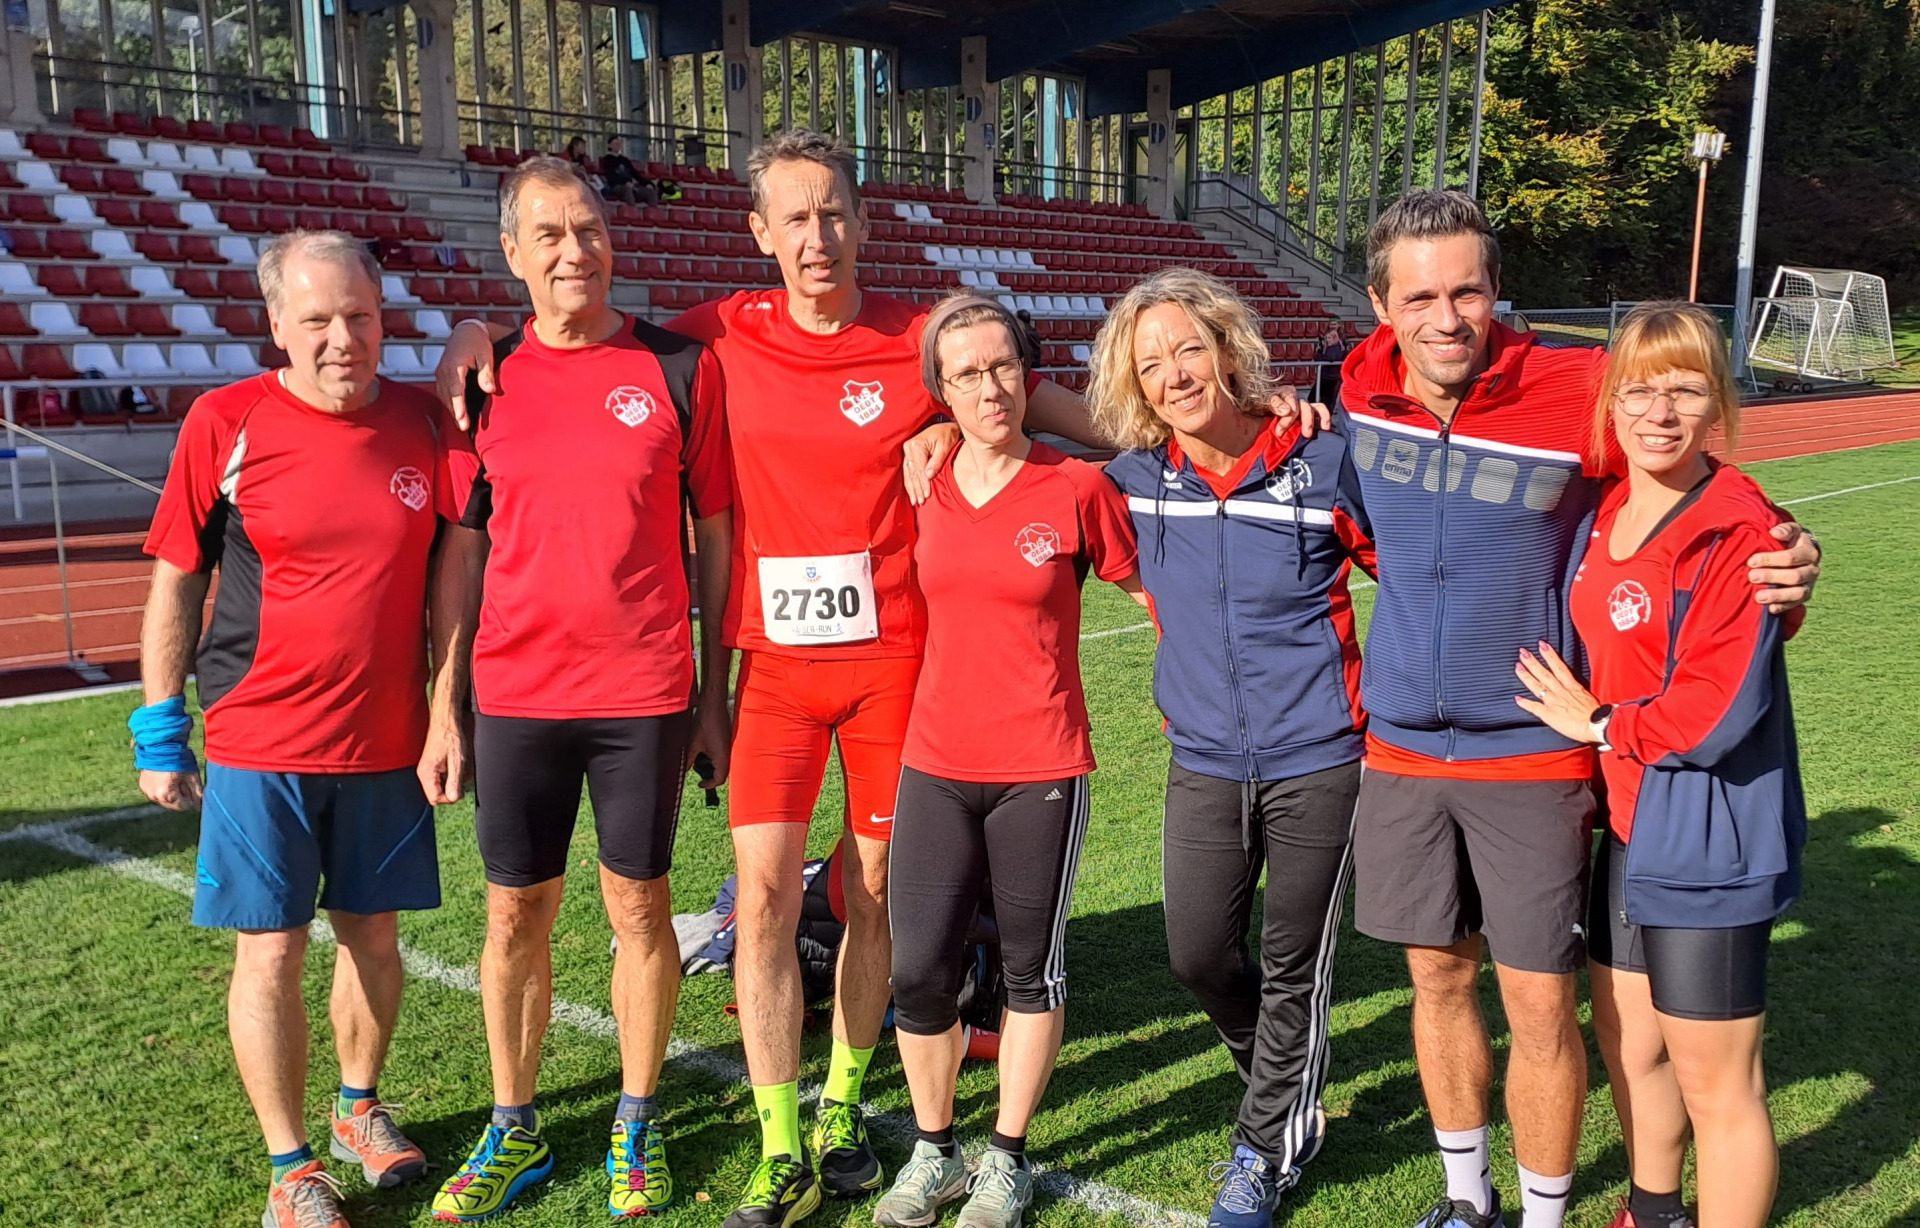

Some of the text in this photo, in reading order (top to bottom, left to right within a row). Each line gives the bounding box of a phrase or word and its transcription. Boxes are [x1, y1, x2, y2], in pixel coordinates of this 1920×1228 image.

[854, 396, 876, 414] OEDT
[860, 404, 881, 421] 1884
[772, 585, 860, 621] 2730
